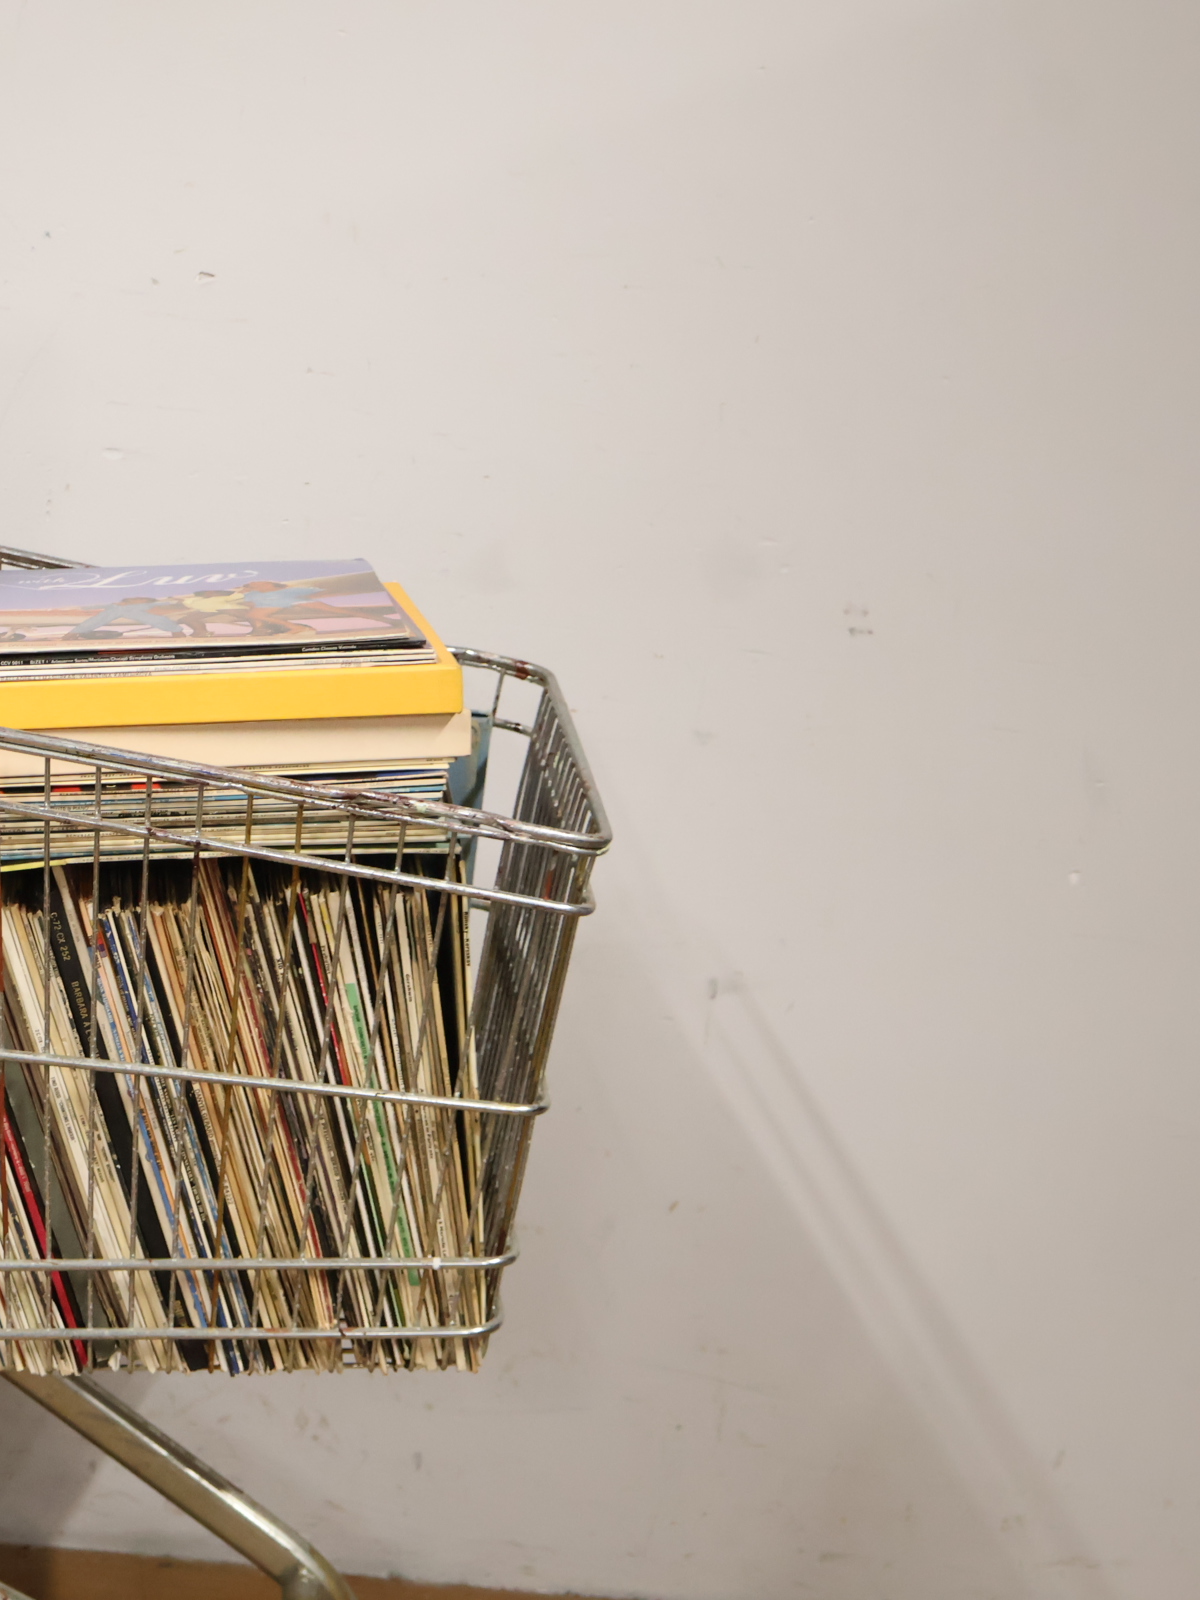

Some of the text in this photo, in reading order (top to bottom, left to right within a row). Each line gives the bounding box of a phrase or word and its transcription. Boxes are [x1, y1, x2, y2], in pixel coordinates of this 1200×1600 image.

[59, 944, 71, 961] 252
[69, 980, 88, 1019] BARBARA
[404, 973, 413, 1002] Gershwin
[101, 993, 114, 1023] WIJNGAARD
[194, 1088, 206, 1112] DANYEL
